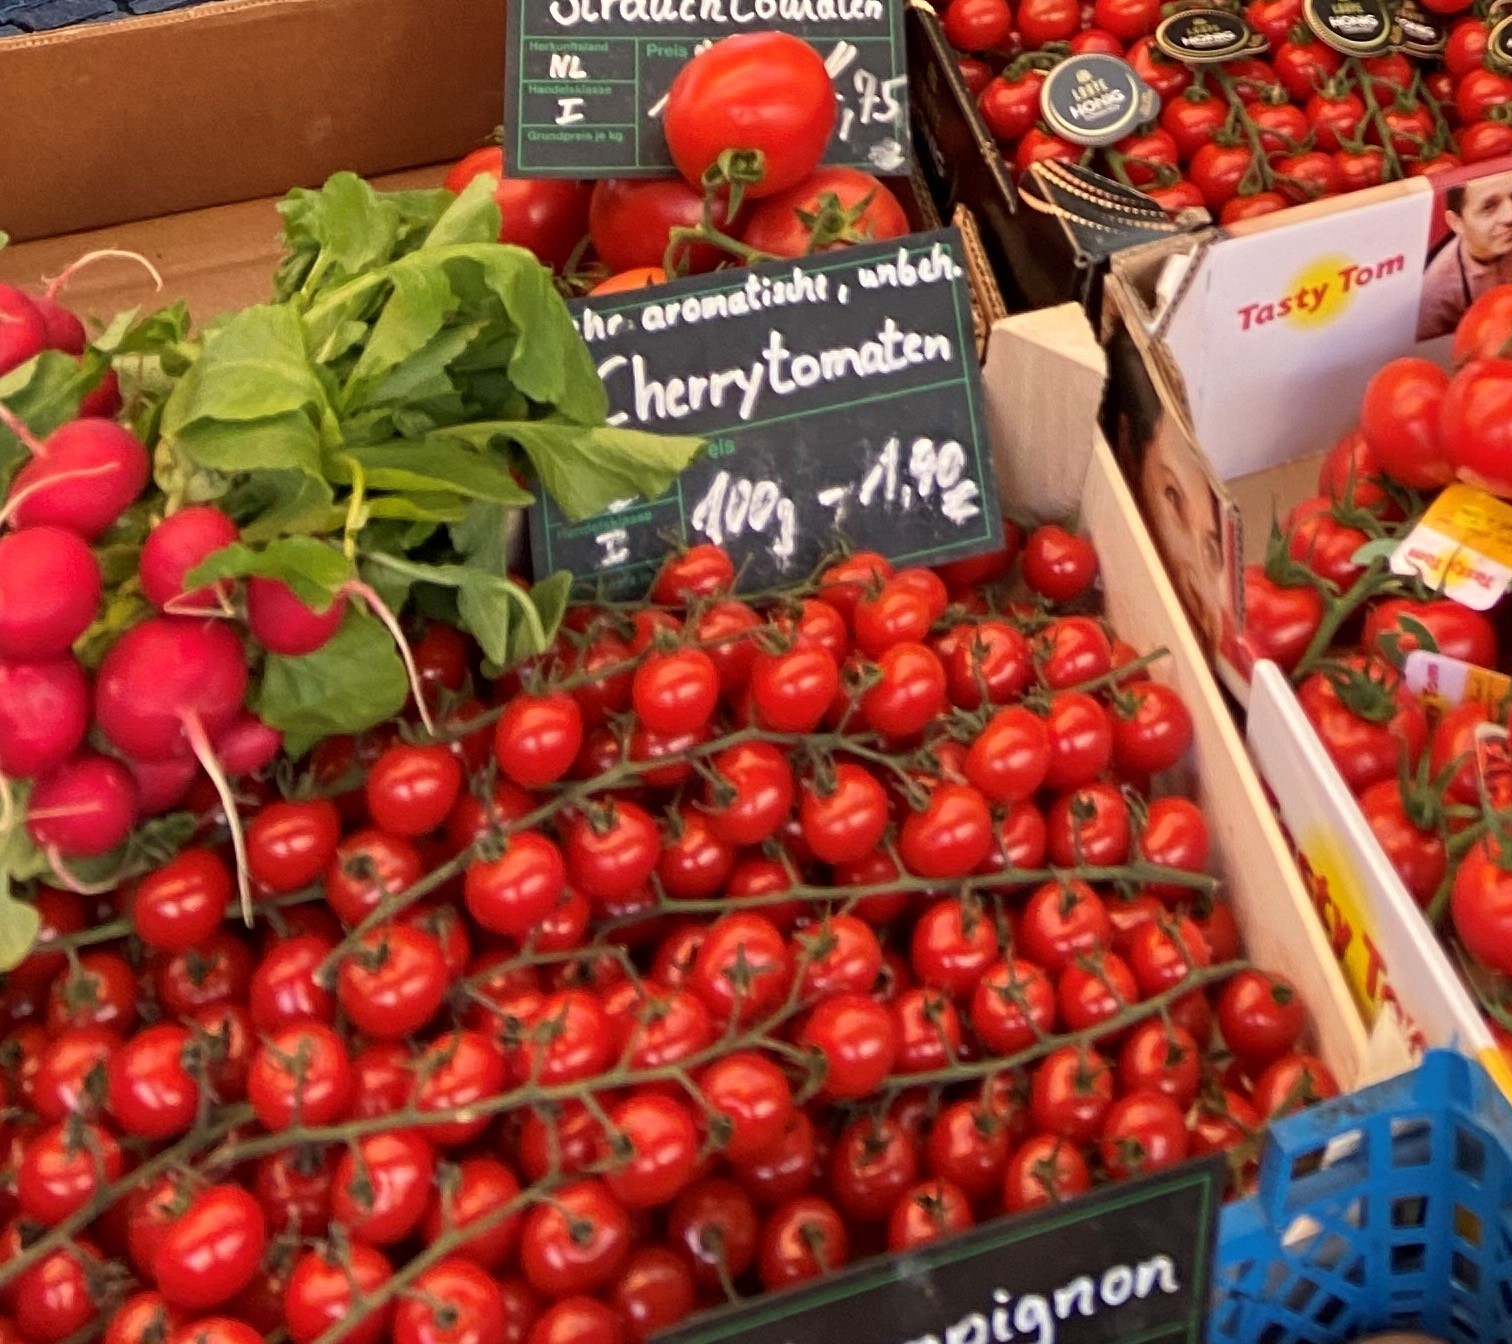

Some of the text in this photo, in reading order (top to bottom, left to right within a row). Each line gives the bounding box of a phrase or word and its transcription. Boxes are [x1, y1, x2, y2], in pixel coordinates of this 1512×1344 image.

[550, 53, 587, 79] NL
[646, 43, 689, 58] Preis
[609, 130, 624, 142] kg
[858, 243, 963, 290] unbeh.
[1237, 253, 1406, 332] Tasty Tom
[692, 470, 797, 574] 100g
